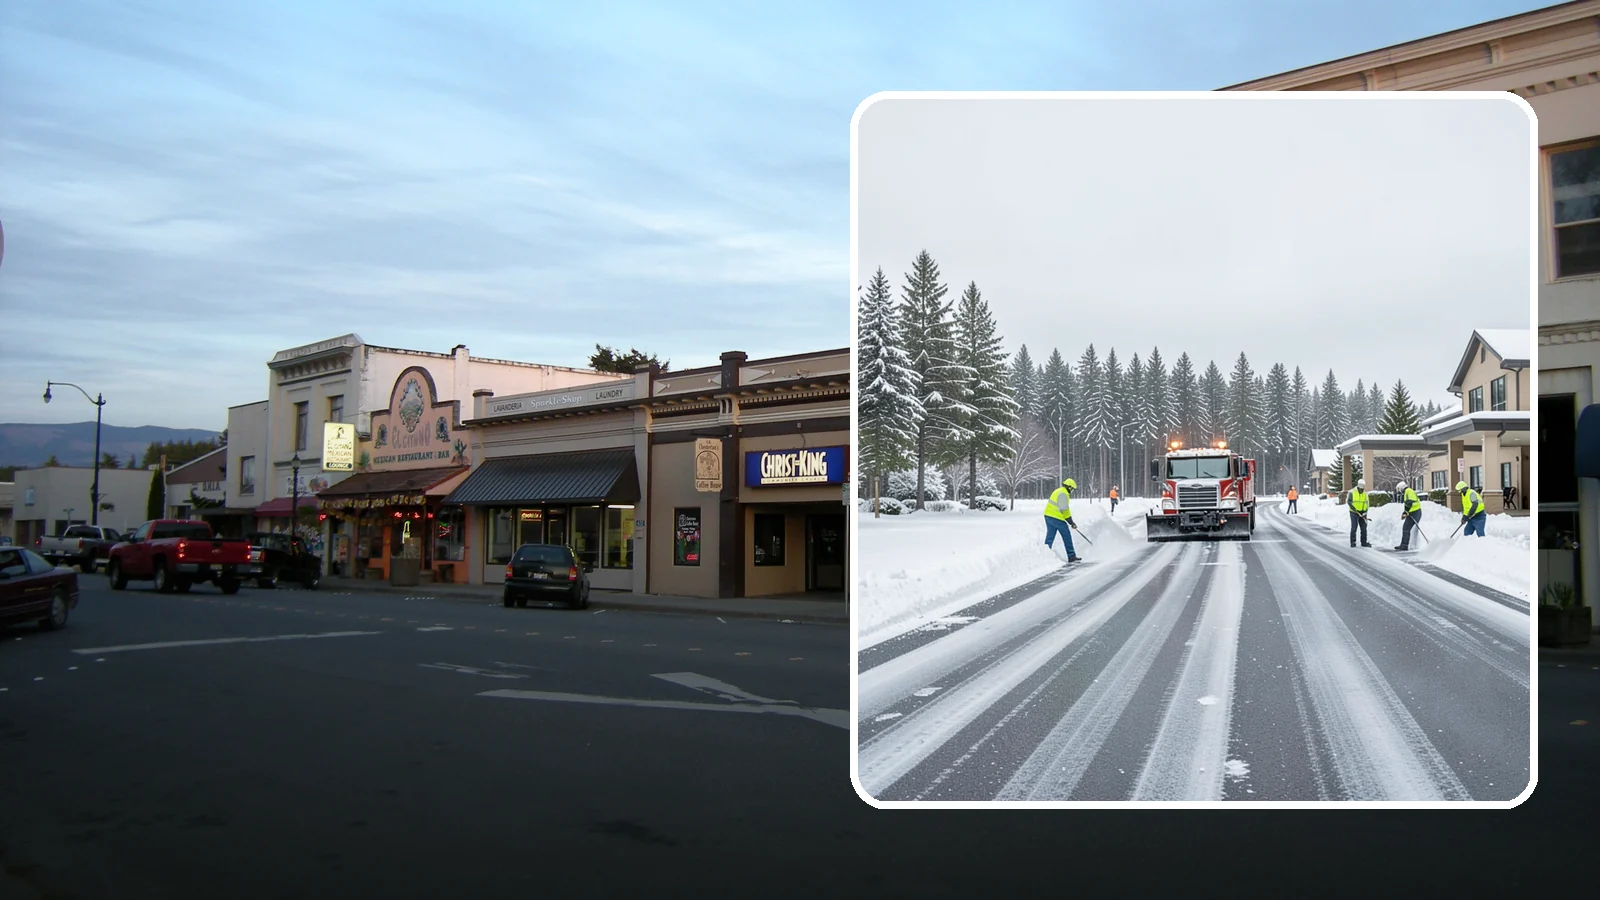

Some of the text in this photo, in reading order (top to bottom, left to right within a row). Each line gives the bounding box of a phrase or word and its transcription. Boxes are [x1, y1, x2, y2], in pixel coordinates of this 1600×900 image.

[561, 394, 582, 405] Shop
[596, 389, 623, 400] LAUNDRY
[493, 402, 523, 413] LAVANDERIA
[374, 450, 450, 464] MEXICAN RESTAURANT BAR
